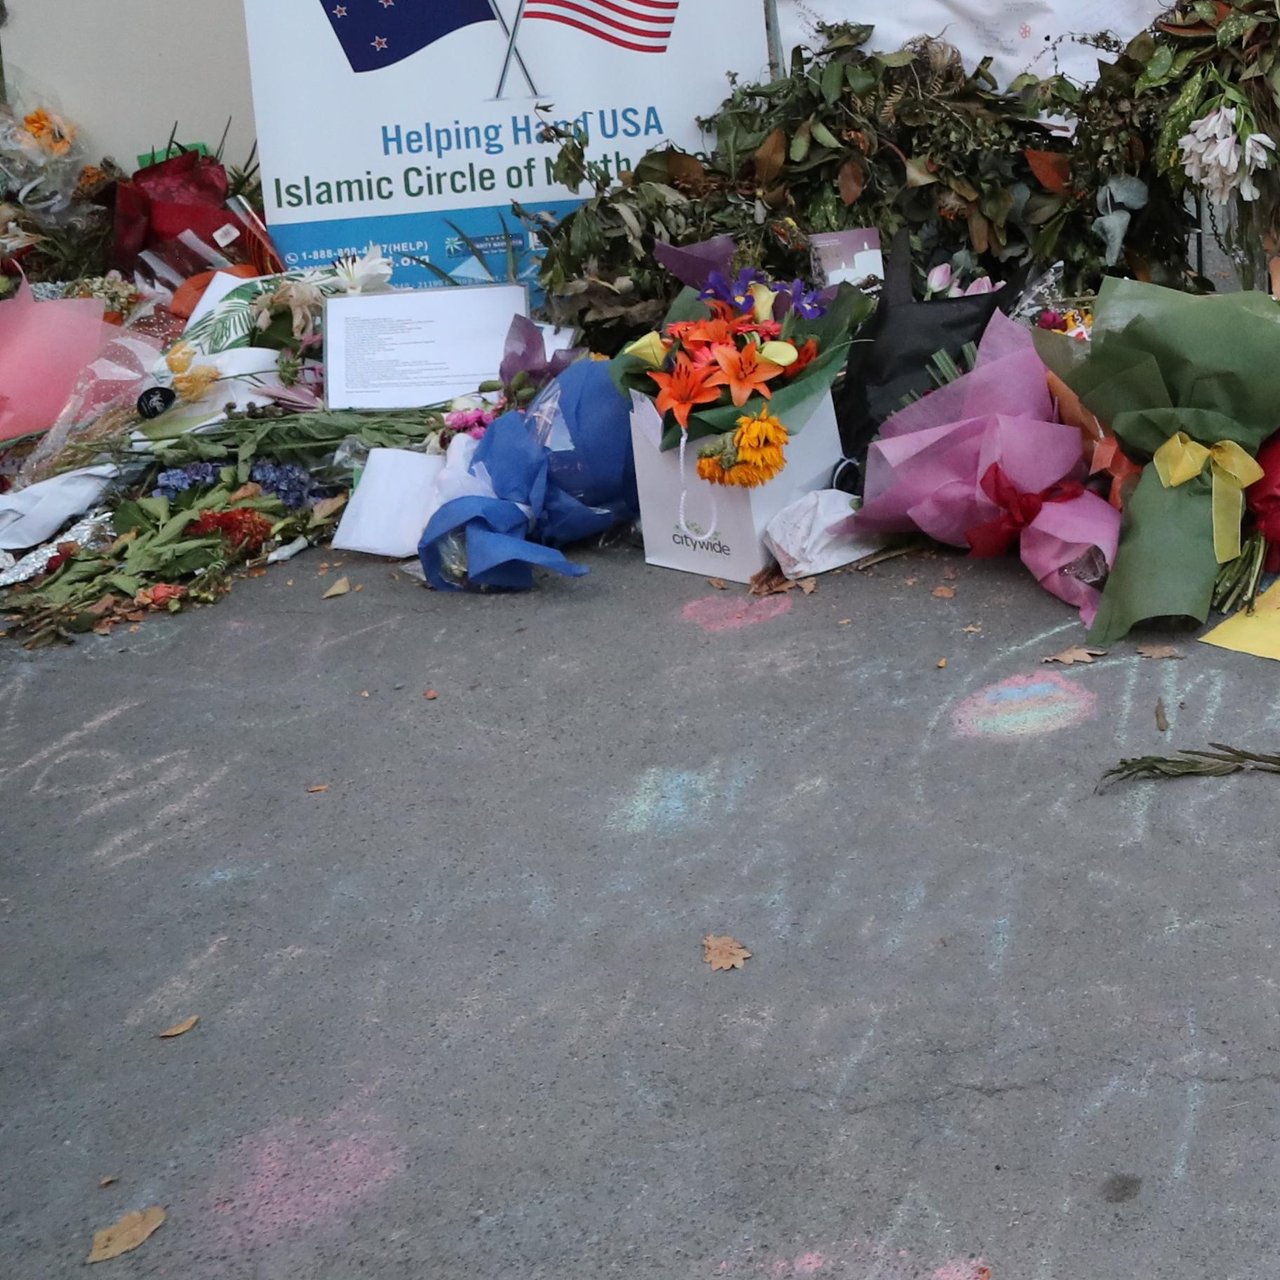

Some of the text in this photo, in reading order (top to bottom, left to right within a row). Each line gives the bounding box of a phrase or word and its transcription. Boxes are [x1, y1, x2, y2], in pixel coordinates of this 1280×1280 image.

[381, 121, 504, 158] Helping
[600, 106, 664, 139] USA
[275, 166, 394, 209] Islamic
[403, 160, 496, 196] Circle
[506, 157, 536, 189] of
[671, 531, 731, 557] citywide
